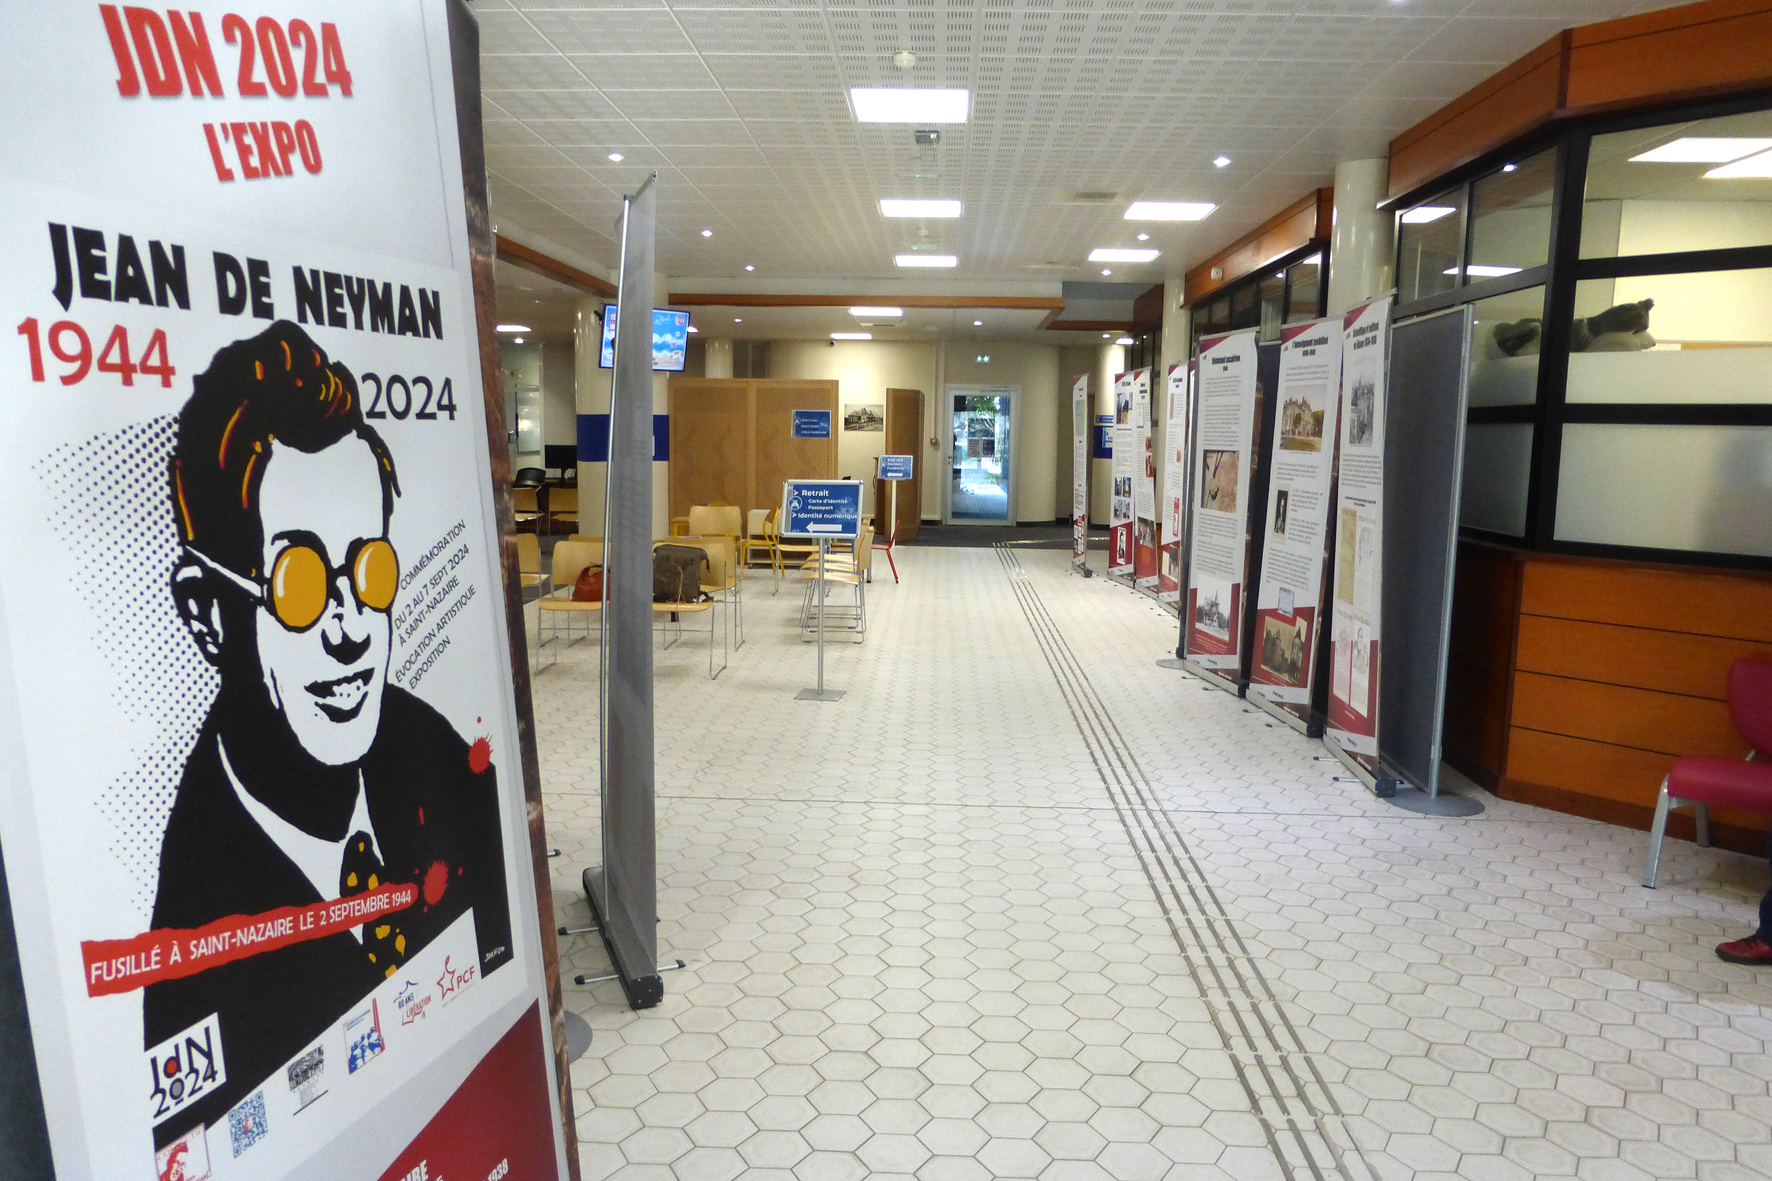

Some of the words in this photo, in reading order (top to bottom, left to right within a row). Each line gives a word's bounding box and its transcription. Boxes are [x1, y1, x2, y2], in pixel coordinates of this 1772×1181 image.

[99, 3, 225, 97] JDN
[221, 13, 353, 98] 2024
[203, 119, 323, 182] L'EXPO
[48, 222, 191, 312] JEAN
[212, 251, 275, 321] DE
[292, 265, 444, 340] NEYMAN
[17, 316, 176, 388] 1944
[361, 372, 457, 421] 2024
[394, 615, 407, 630] DU
[407, 602, 415, 616] 2
[413, 595, 425, 611] AU
[423, 583, 429, 596] 7
[430, 567, 449, 590] SEPT
[448, 544, 470, 570] 2024
[400, 519, 466, 590] COMMÉMORATION
[395, 628, 437, 683] ÉVOCATION
[437, 584, 477, 634] ARTISTIQUE
[399, 633, 407, 647] À
[407, 575, 460, 639] SAINT-NAZAIRE
[409, 635, 451, 690] EXPOSITION
[91, 947, 161, 984] FUSILLÉ
[170, 940, 182, 965] À
[190, 916, 294, 960] SAINT-NAZAIRE
[300, 912, 314, 931] LE
[320, 910, 327, 925] 2
[330, 894, 390, 923] SEPTEMBRE
[391, 890, 411, 907] 1944
[406, 994, 432, 1018] LIBÉRATION
[457, 965, 475, 989] PCF
[150, 1067, 218, 1119] 2024
